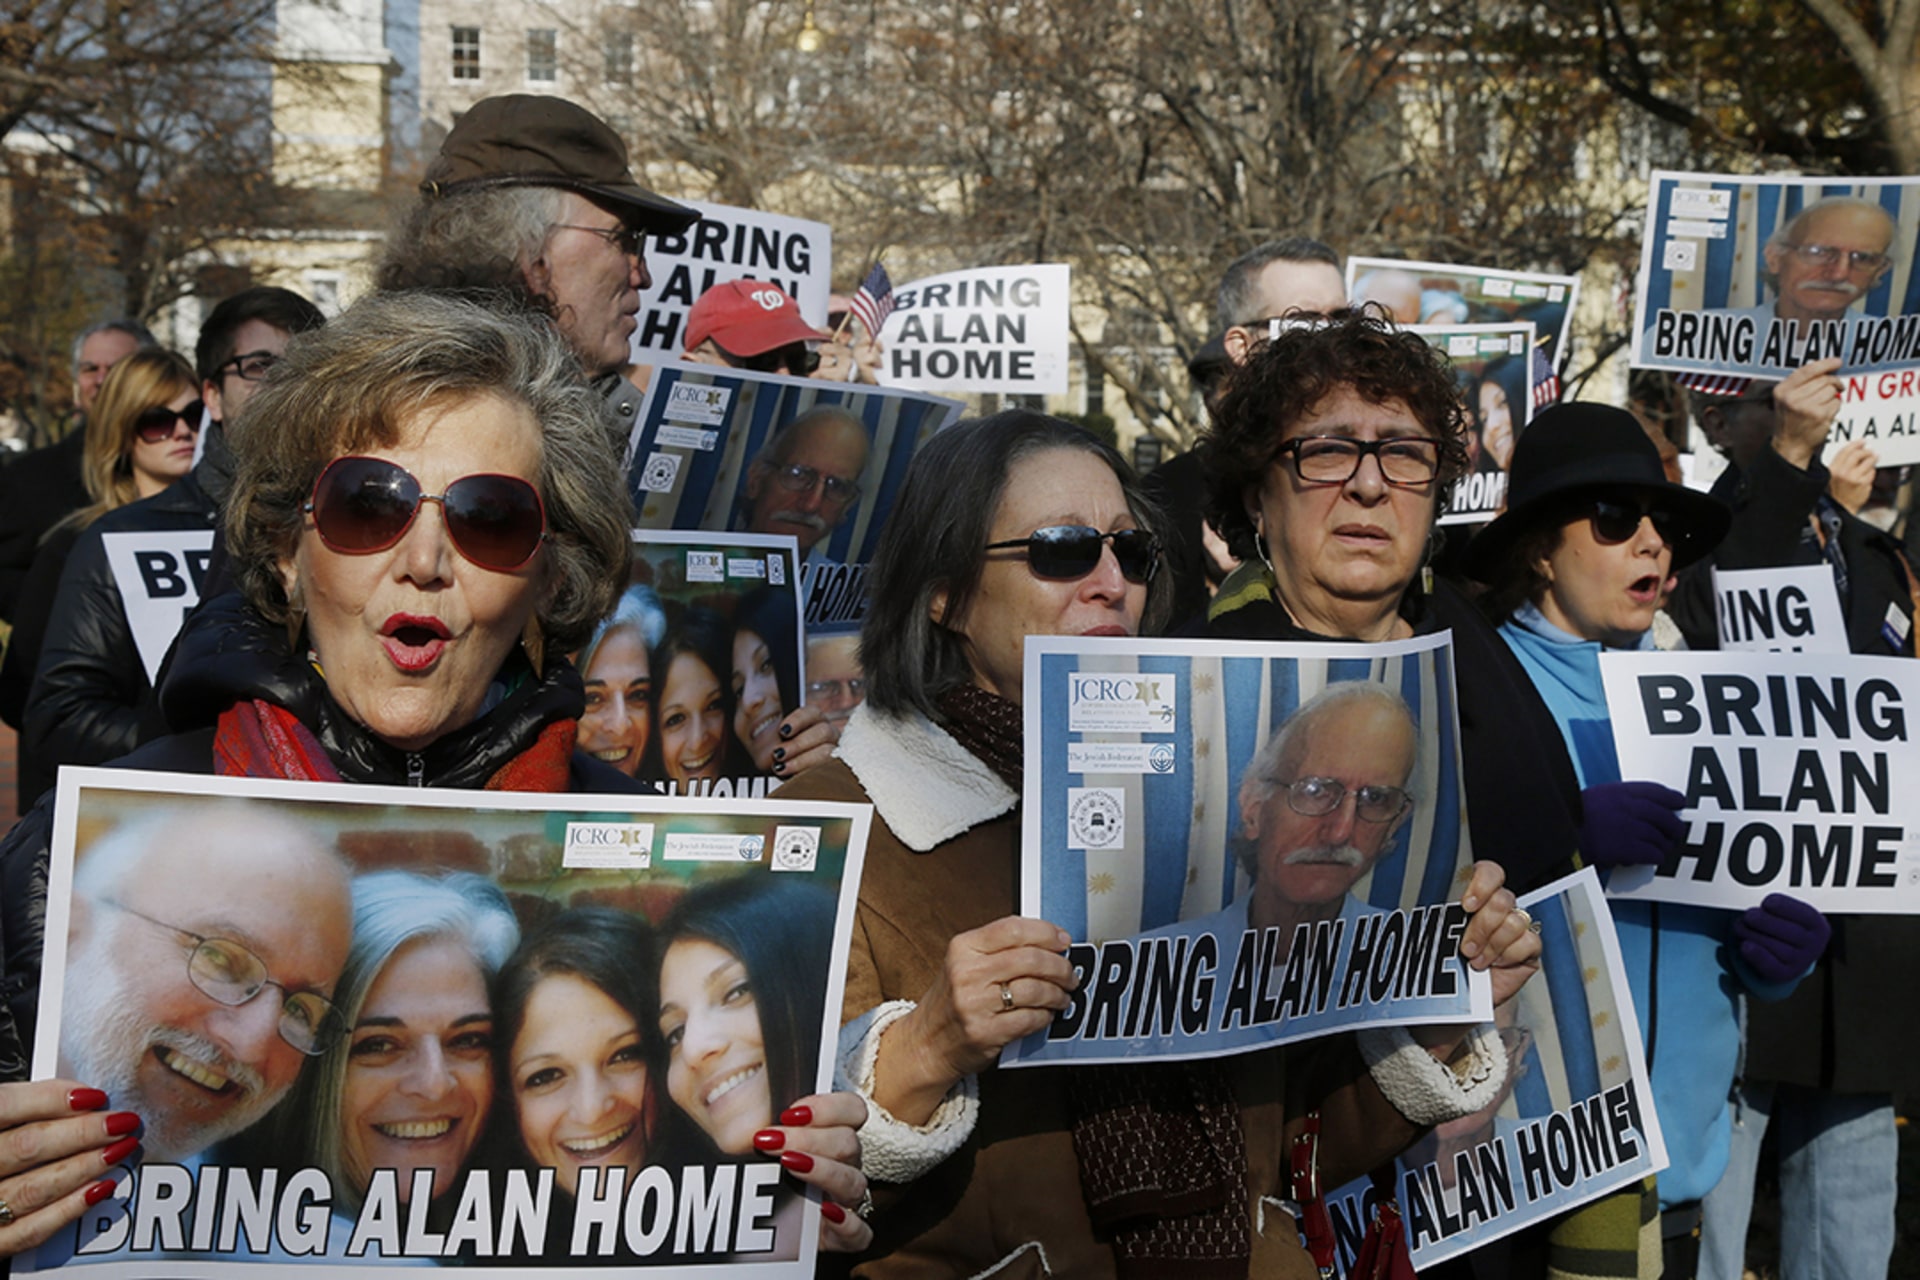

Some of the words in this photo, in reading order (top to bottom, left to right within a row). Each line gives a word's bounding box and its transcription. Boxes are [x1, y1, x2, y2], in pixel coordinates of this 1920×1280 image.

[893, 277, 1042, 312] BRING
[897, 313, 1027, 344] ALAN
[1655, 310, 1754, 363] BRING
[1760, 319, 1847, 369] ALAN
[891, 348, 1036, 380] HOME
[1863, 416, 1878, 439] A
[1072, 678, 1132, 706] JCRC
[1637, 673, 1908, 743] BRING
[1684, 745, 1890, 815] ALAN
[568, 827, 619, 848] JCRC
[1654, 820, 1905, 888] HOME
[1047, 932, 1218, 1041] BRING
[1219, 918, 1345, 1031] ALAN
[1337, 902, 1468, 1010] HOME
[1402, 1136, 1516, 1253] ALAN
[1514, 1082, 1641, 1204] HOME
[74, 1162, 333, 1257] BRING
[344, 1167, 556, 1258] ALAN
[568, 1162, 784, 1257] HOME
